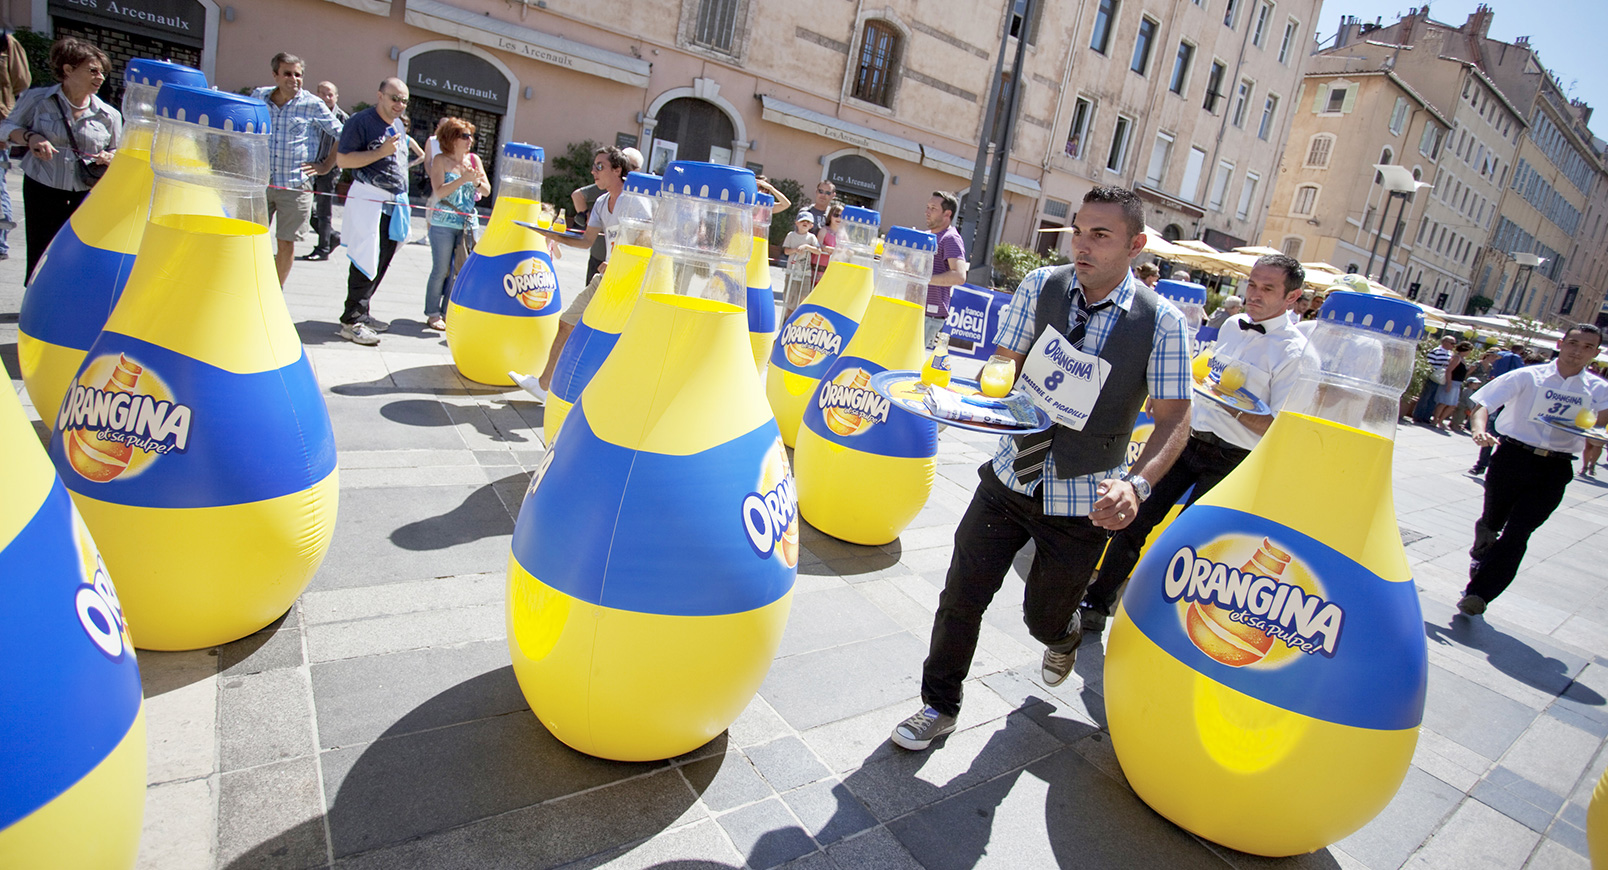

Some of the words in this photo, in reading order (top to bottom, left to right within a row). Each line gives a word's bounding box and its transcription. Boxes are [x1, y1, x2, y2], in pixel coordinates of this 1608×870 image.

[68, 0, 97, 8] es
[106, 1, 190, 31] Arcenaulx
[498, 38, 516, 51] Les
[521, 45, 573, 66] Arcenaulx
[418, 73, 437, 87] Les
[442, 80, 498, 100] Arcenaulx
[824, 128, 837, 138] Les
[832, 173, 844, 182] Les
[845, 176, 876, 190] Arcenaulx
[946, 306, 983, 333] bleu
[965, 306, 984, 318] france
[781, 323, 842, 355] ORANGINA
[951, 328, 981, 340] provence
[1044, 339, 1093, 380] ORANGINA
[1044, 370, 1065, 391] 8
[819, 380, 891, 423] ORANGINA
[1021, 373, 1046, 397] BRASSERIE
[1044, 395, 1053, 403] LE
[1052, 401, 1088, 419] PICADILLY
[1545, 390, 1582, 405] ORANGINA
[1548, 402, 1571, 415] 31
[59, 377, 192, 450] ORANGINA
[97, 428, 110, 441] et
[112, 432, 125, 442] sa
[126, 435, 175, 455] pulpe!
[1165, 547, 1342, 653] ORANGINA
[1231, 610, 1246, 623] et
[1247, 619, 1266, 630] sa
[1266, 625, 1323, 655] pulpe!
